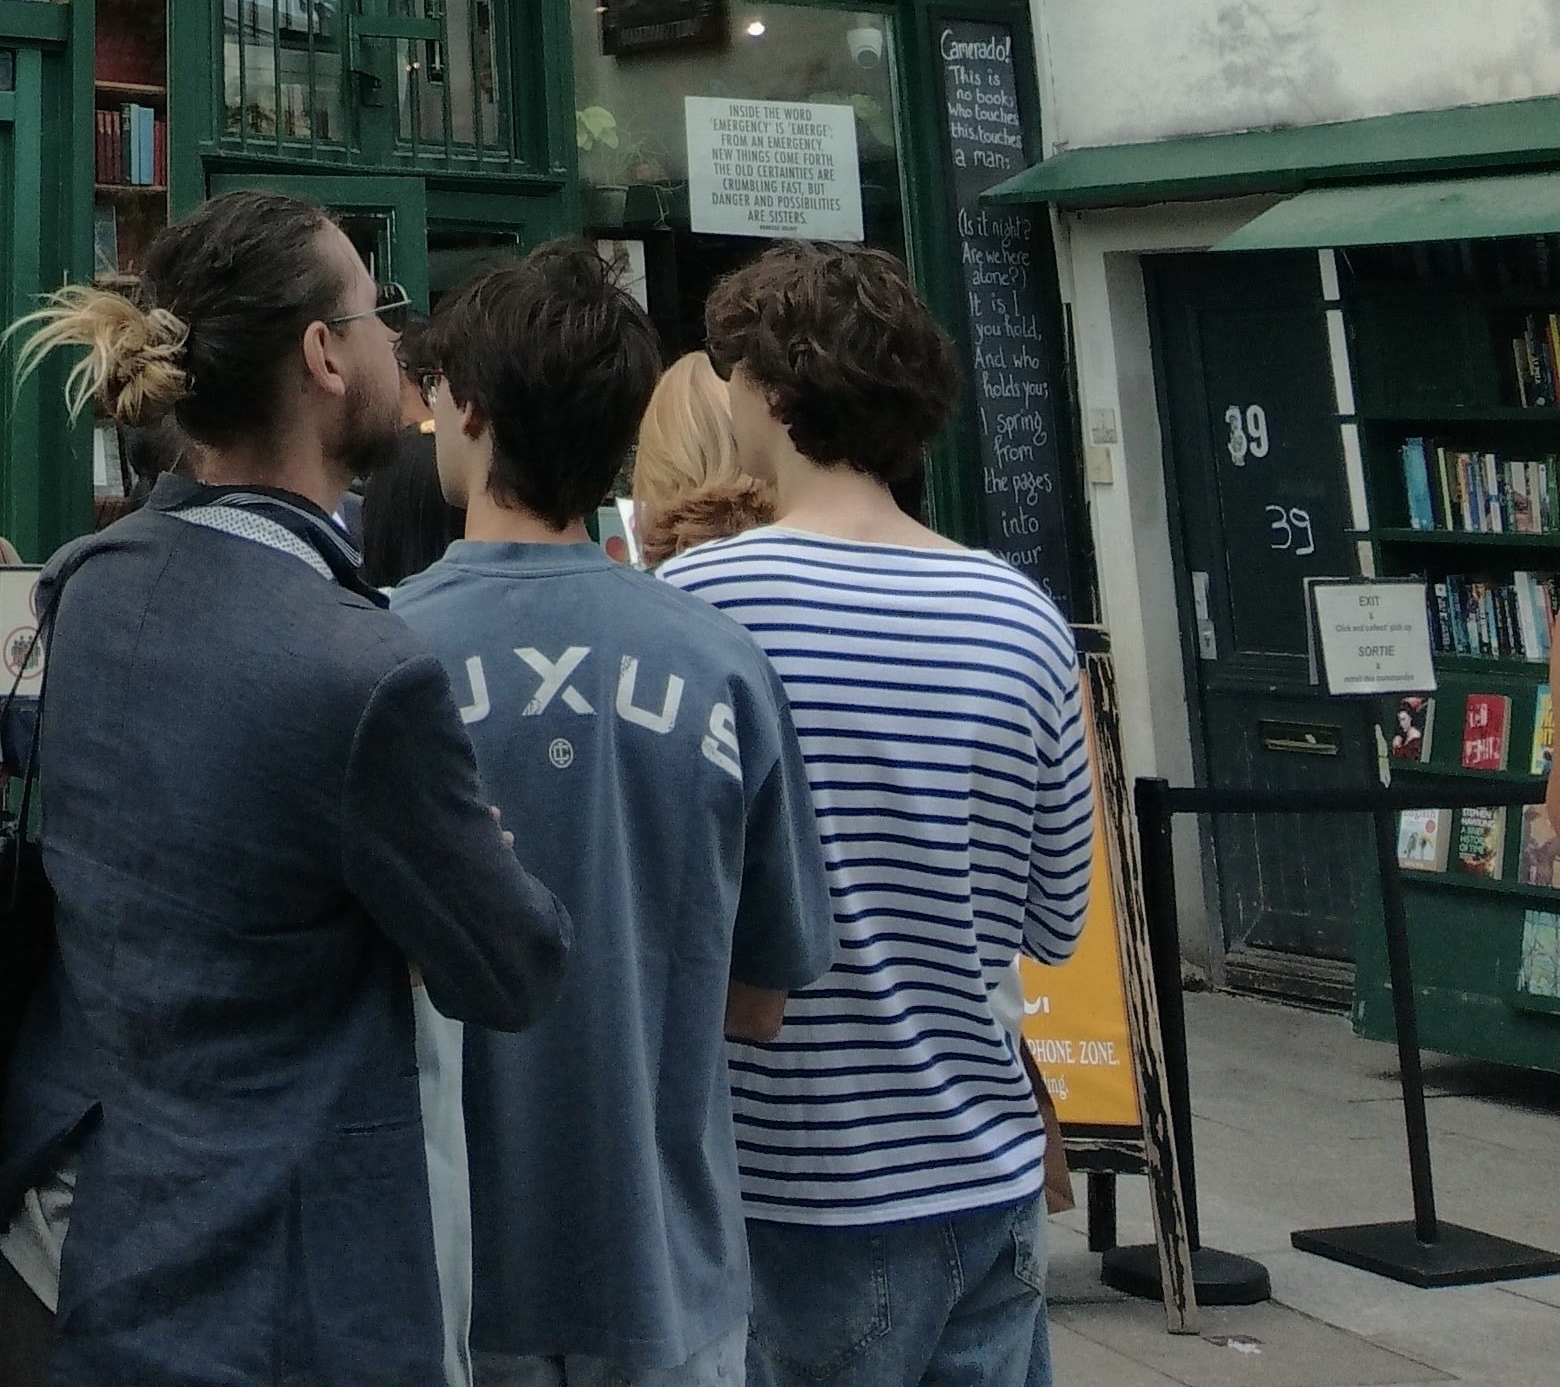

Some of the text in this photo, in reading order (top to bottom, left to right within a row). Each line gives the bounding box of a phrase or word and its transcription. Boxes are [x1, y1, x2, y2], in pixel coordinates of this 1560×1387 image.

[940, 28, 1012, 64] Camerado!
[948, 64, 1002, 87] This is
[956, 88, 973, 102] no
[729, 104, 813, 122] INSIDE THE WORD
[975, 104, 1020, 126] touches
[775, 122, 785, 134] IS
[978, 124, 1023, 150] touches
[721, 133, 749, 147] FROM
[751, 135, 765, 148] AN
[712, 148, 735, 161] NEW
[735, 148, 771, 164] THINGS
[774, 150, 800, 165] COME
[954, 148, 967, 169] a
[713, 162, 836, 182] THE OLD CERTAINTIES ARE
[722, 177, 826, 196] CRUMBLING FAST, BUT
[711, 191, 841, 212] DANGER AND POSSIBILITIES
[747, 209, 808, 225] ARE SISTERS.
[976, 209, 990, 237] it
[991, 214, 1032, 249] night?
[961, 238, 1031, 267] Are we here
[971, 265, 1027, 290] alone?)
[968, 289, 1021, 318] It is I
[975, 323, 1002, 345] you
[974, 344, 1040, 371] And who
[982, 370, 1021, 399] holds
[980, 406, 1048, 447] I spring
[994, 434, 1035, 470] from
[983, 466, 1053, 507] the pages
[1001, 506, 1040, 539] into
[1265, 504, 1315, 556] 39
[1358, 595, 1380, 607] EXIT
[1358, 645, 1396, 657] SORTIE
[1079, 1041, 1121, 1066] ZONE.
